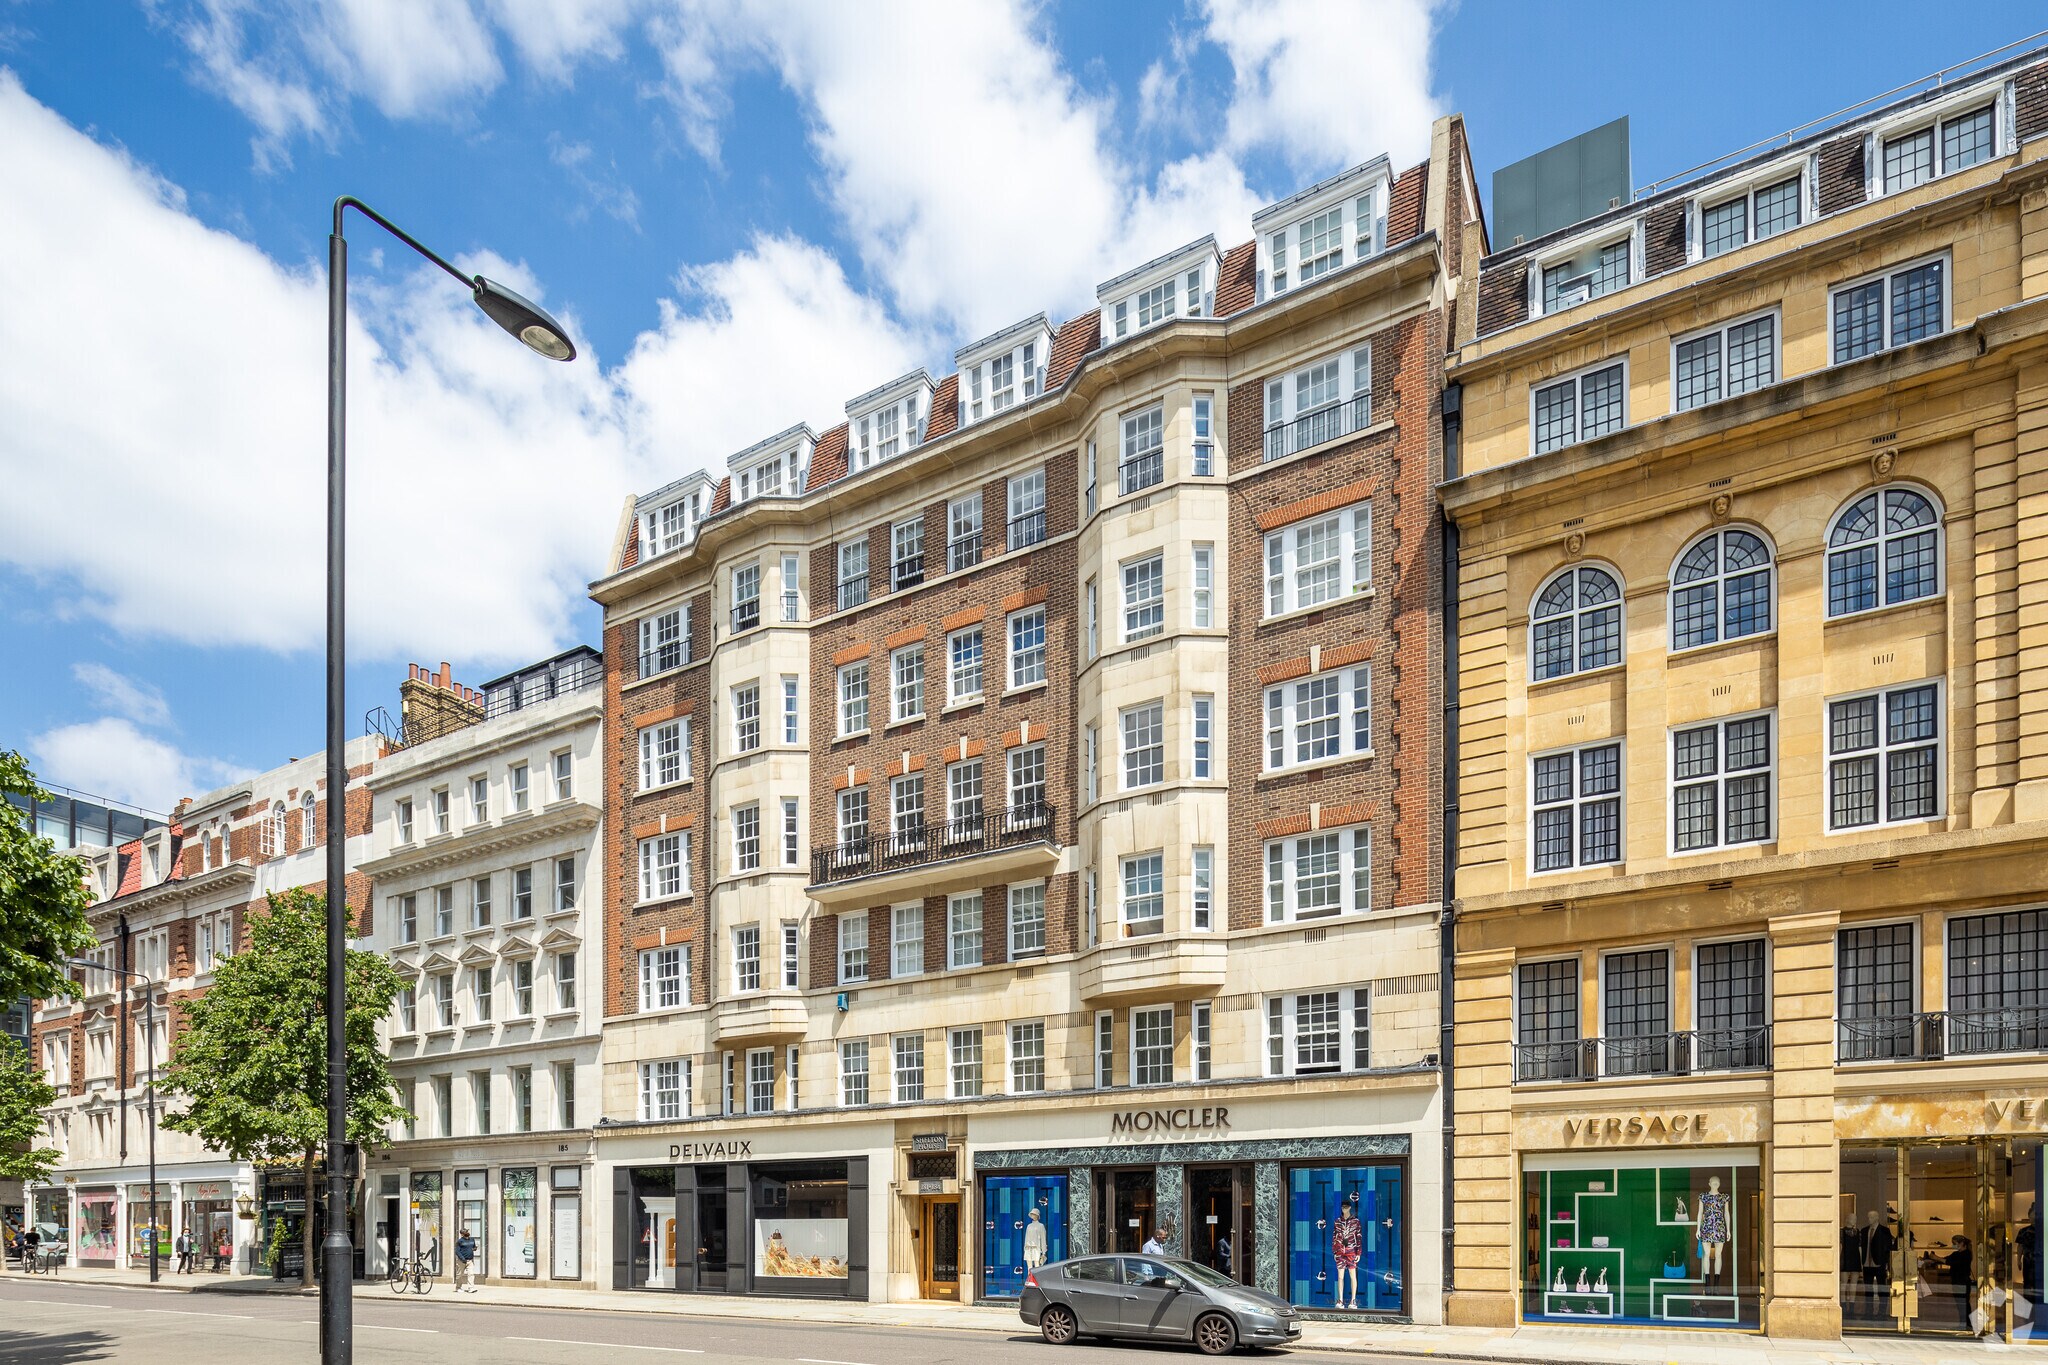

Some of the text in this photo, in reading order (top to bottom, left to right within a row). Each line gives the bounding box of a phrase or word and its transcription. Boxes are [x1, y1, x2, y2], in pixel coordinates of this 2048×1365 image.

[1112, 1107, 1231, 1133] MONCLER
[1566, 1113, 1709, 1136] VERSACE
[558, 1144, 569, 1152] 185
[915, 1136, 944, 1144] SHELTON
[670, 1141, 753, 1158] DELVAUX
